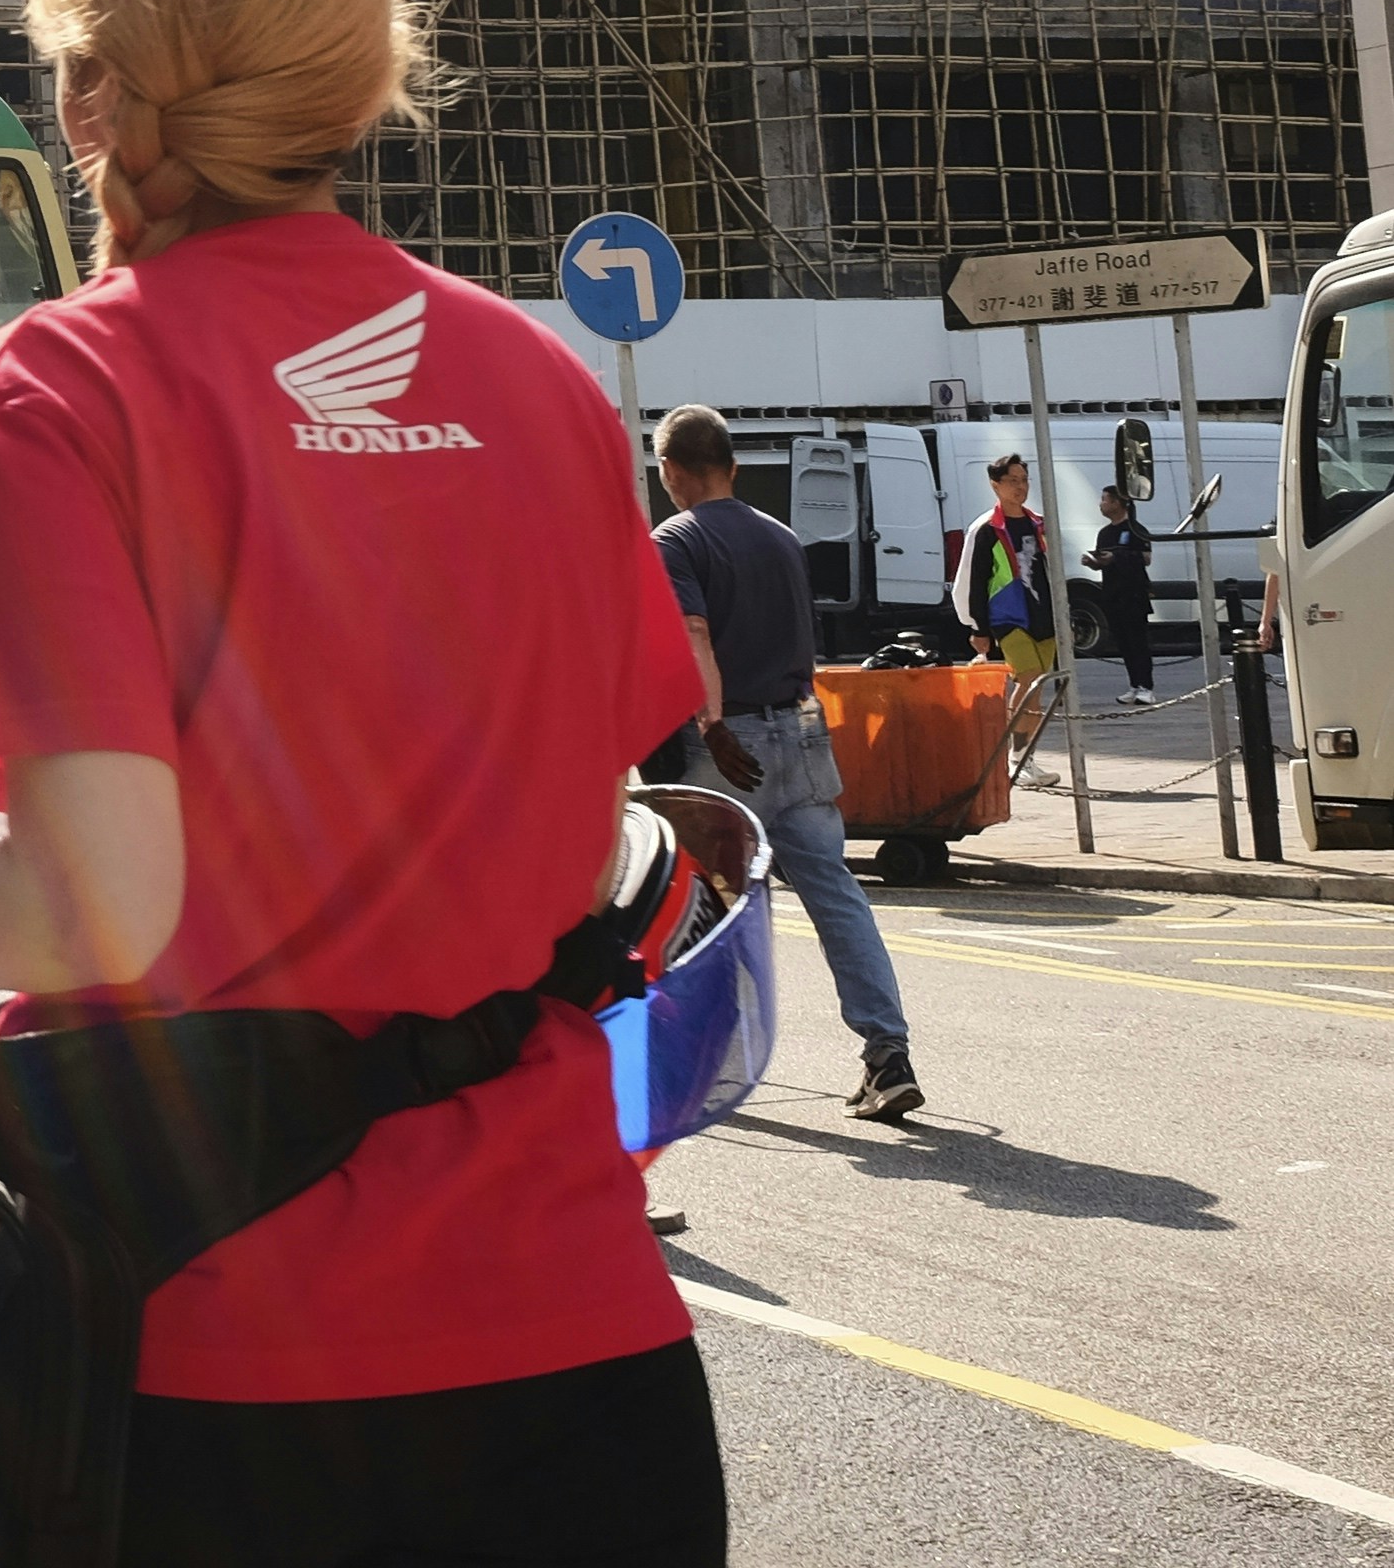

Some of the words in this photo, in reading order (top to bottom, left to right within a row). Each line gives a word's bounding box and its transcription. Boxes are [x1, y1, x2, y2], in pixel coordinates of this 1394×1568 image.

[1034, 255, 1089, 277] Jaffe
[1095, 249, 1152, 272] Road
[977, 294, 1044, 313] 377-421
[1050, 282, 1142, 312] 謝斐道
[1149, 280, 1220, 300] 477-517
[289, 422, 485, 454] HONDA
